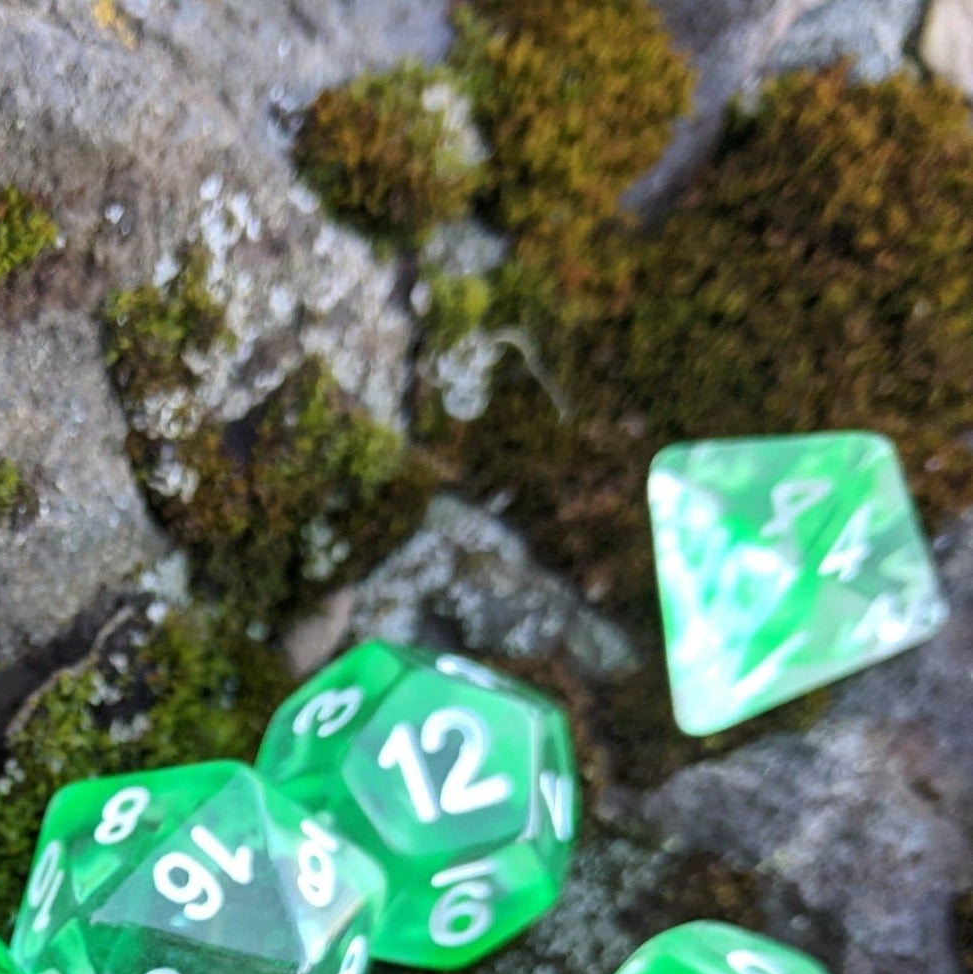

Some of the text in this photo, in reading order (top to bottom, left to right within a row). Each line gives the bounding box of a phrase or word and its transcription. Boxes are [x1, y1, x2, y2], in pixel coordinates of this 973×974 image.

[292, 686, 363, 738] 3
[377, 706, 512, 823] 12
[93, 786, 150, 844] 8
[153, 825, 254, 921] 16
